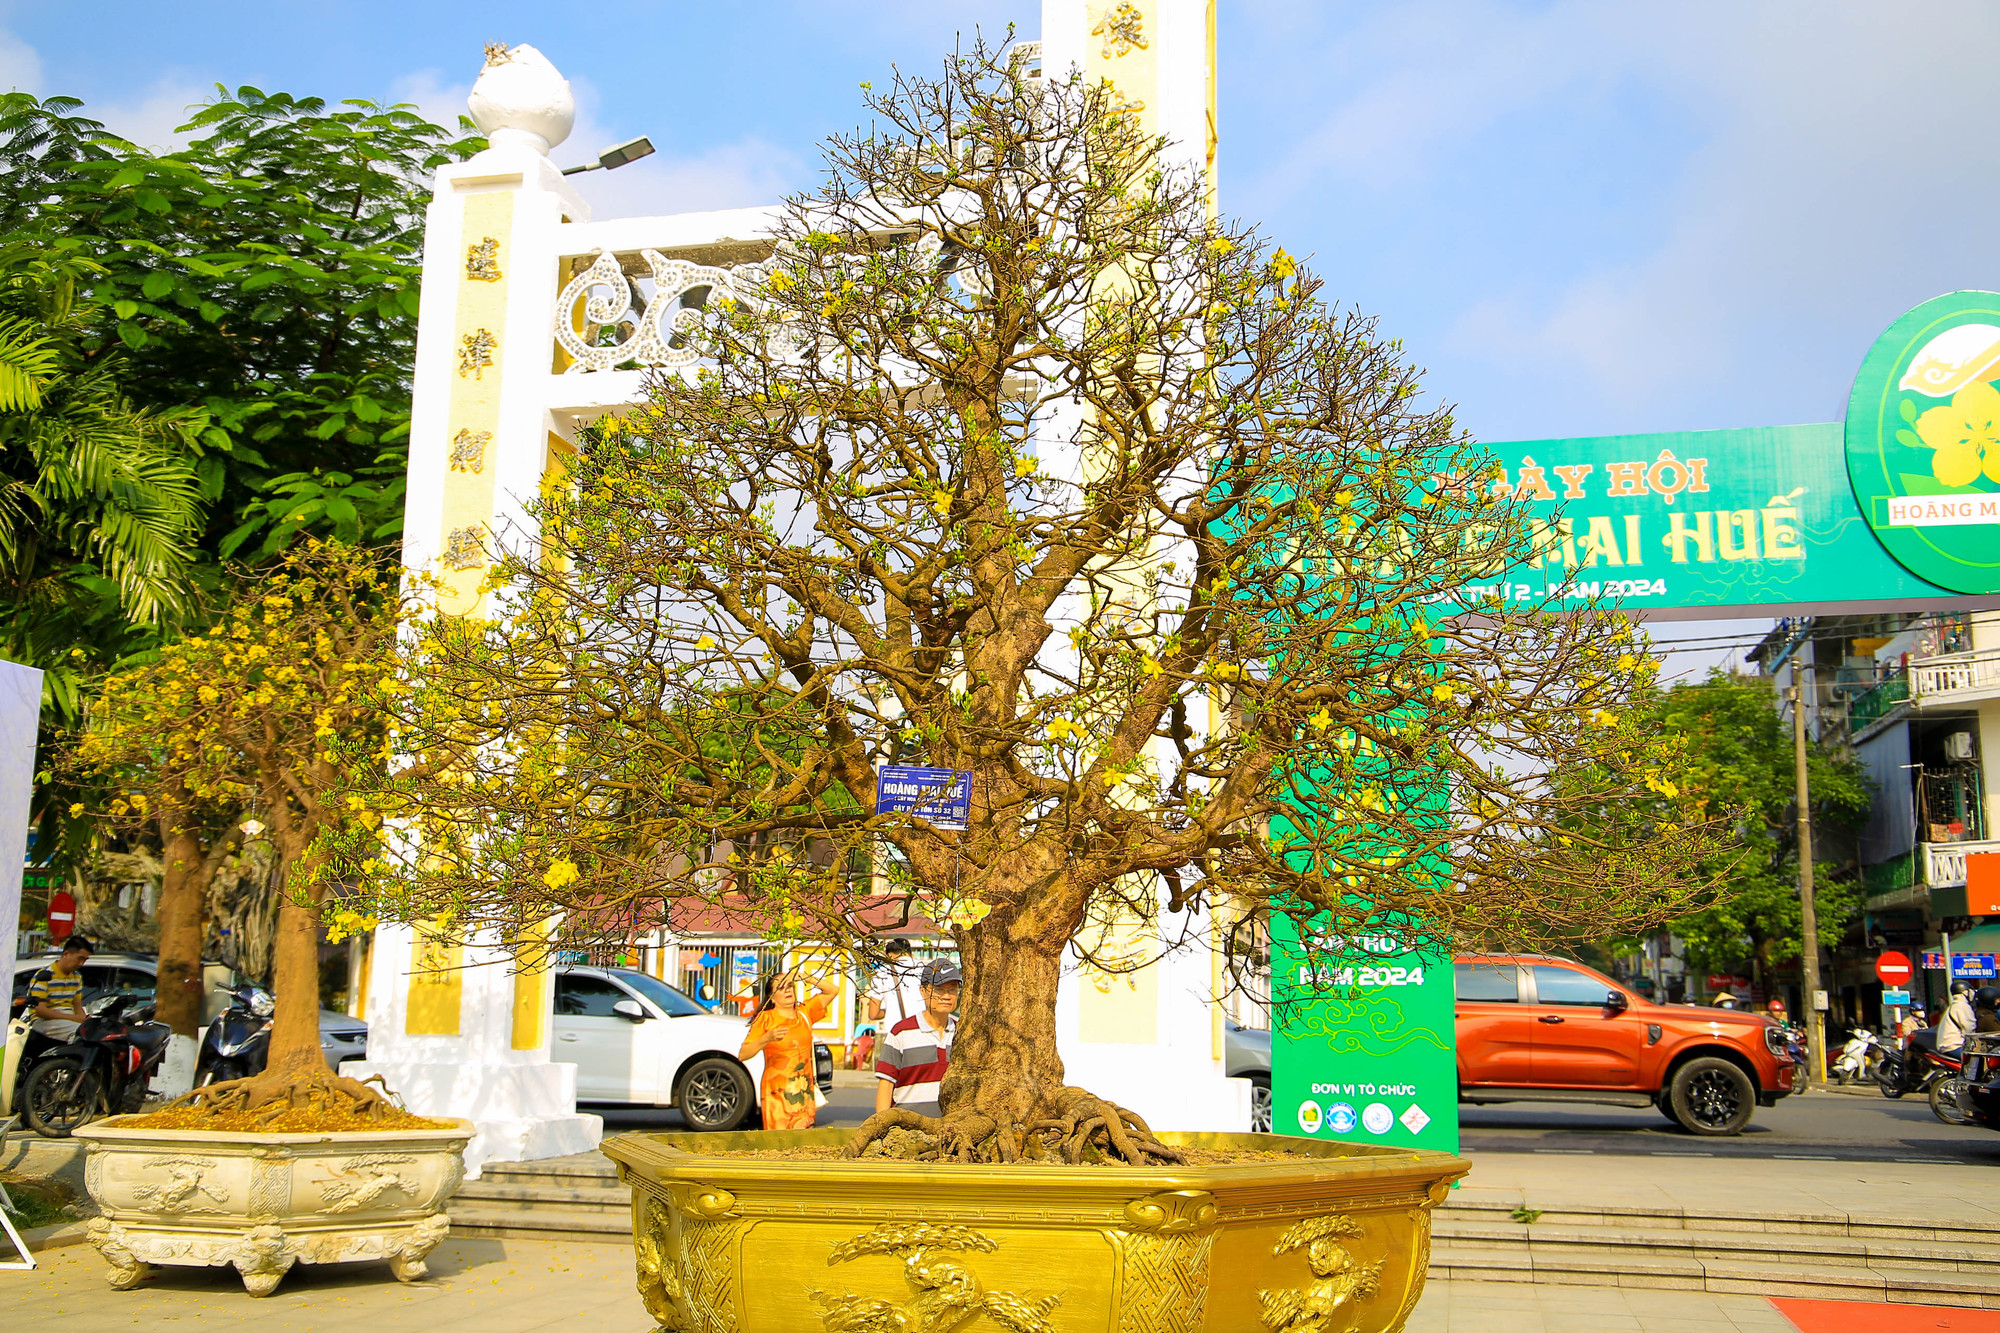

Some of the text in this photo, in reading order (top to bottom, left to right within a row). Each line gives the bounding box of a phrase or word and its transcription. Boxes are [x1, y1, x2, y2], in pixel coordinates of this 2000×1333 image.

[1606, 449, 1709, 505] HỘI
[1527, 514, 1643, 569] MAI
[1662, 486, 1806, 563] HUẾ
[1514, 584, 1531, 601] 2
[1604, 578, 1667, 598] 2024
[883, 781, 918, 795] HOÀNG
[1358, 967, 1424, 985] 2024
[1311, 1083, 1340, 1094] ĐƠN
[1343, 1084, 1355, 1097] VỊ
[1378, 1082, 1416, 1095] CHỨC
